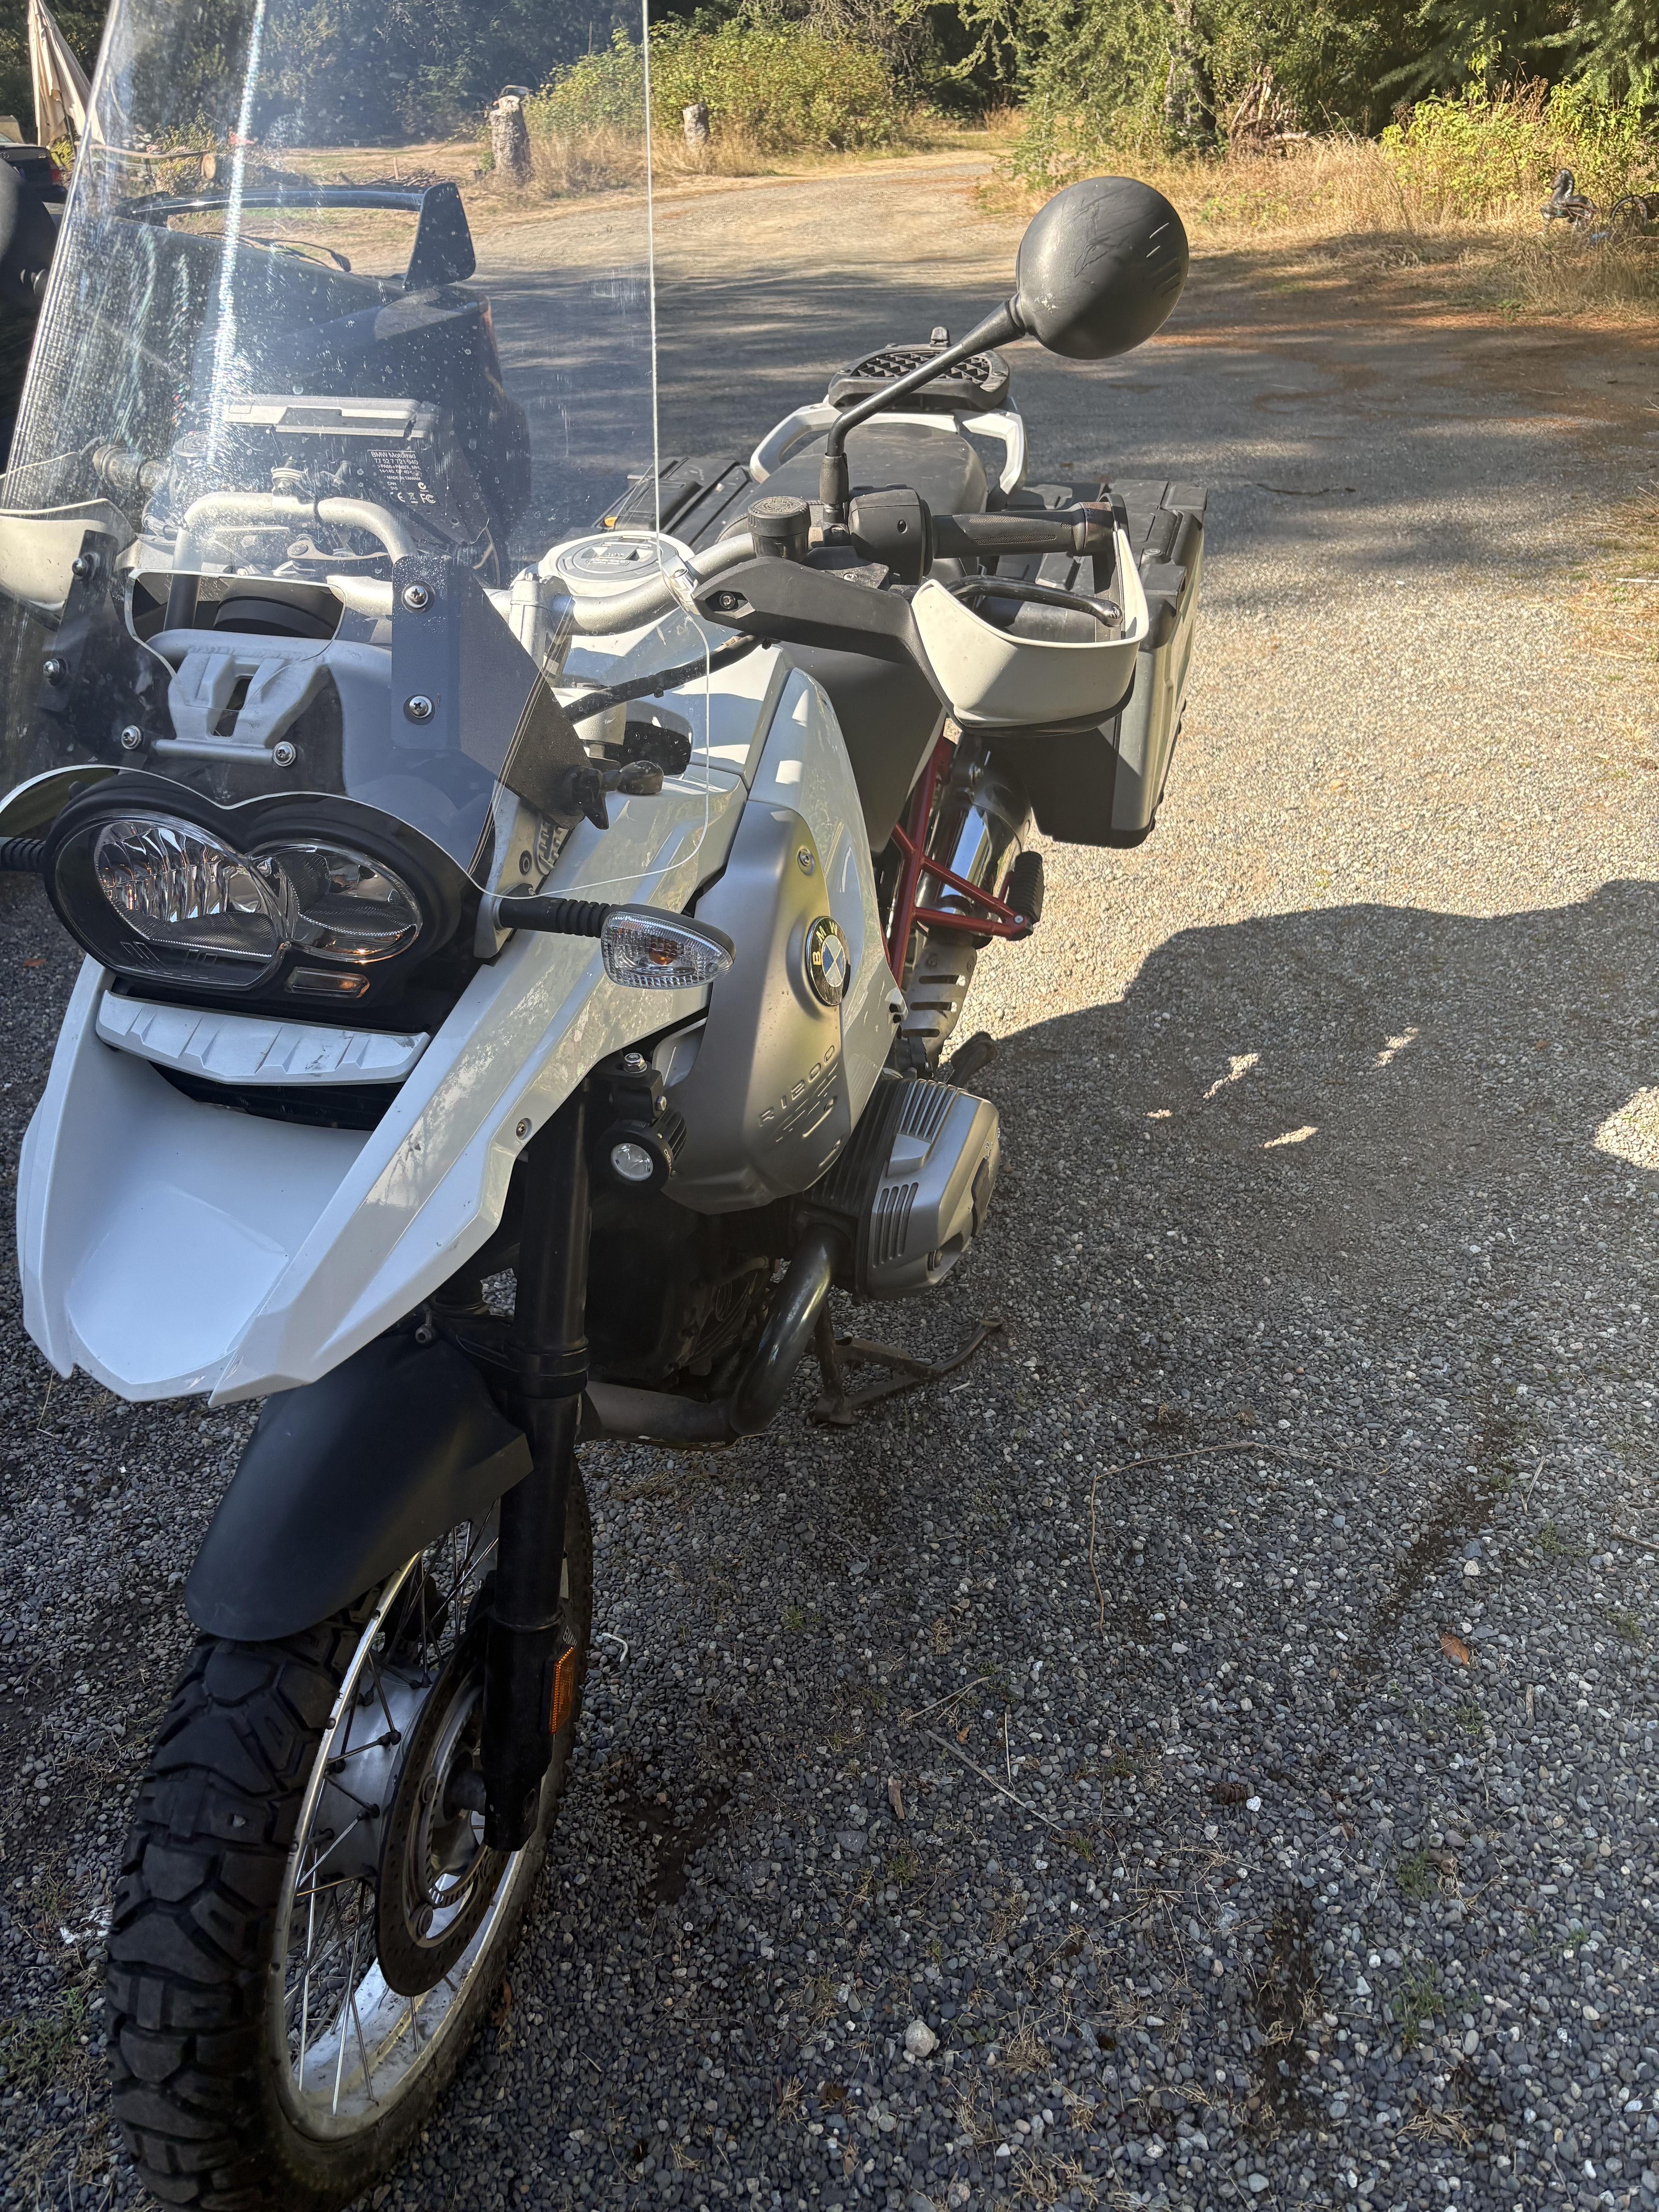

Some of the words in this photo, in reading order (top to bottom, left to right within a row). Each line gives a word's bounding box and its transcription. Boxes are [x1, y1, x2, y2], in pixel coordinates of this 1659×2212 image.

[812, 921, 837, 965] BMW
[759, 1044, 835, 1127] R1200
[563, 1625, 577, 1648] BMW
